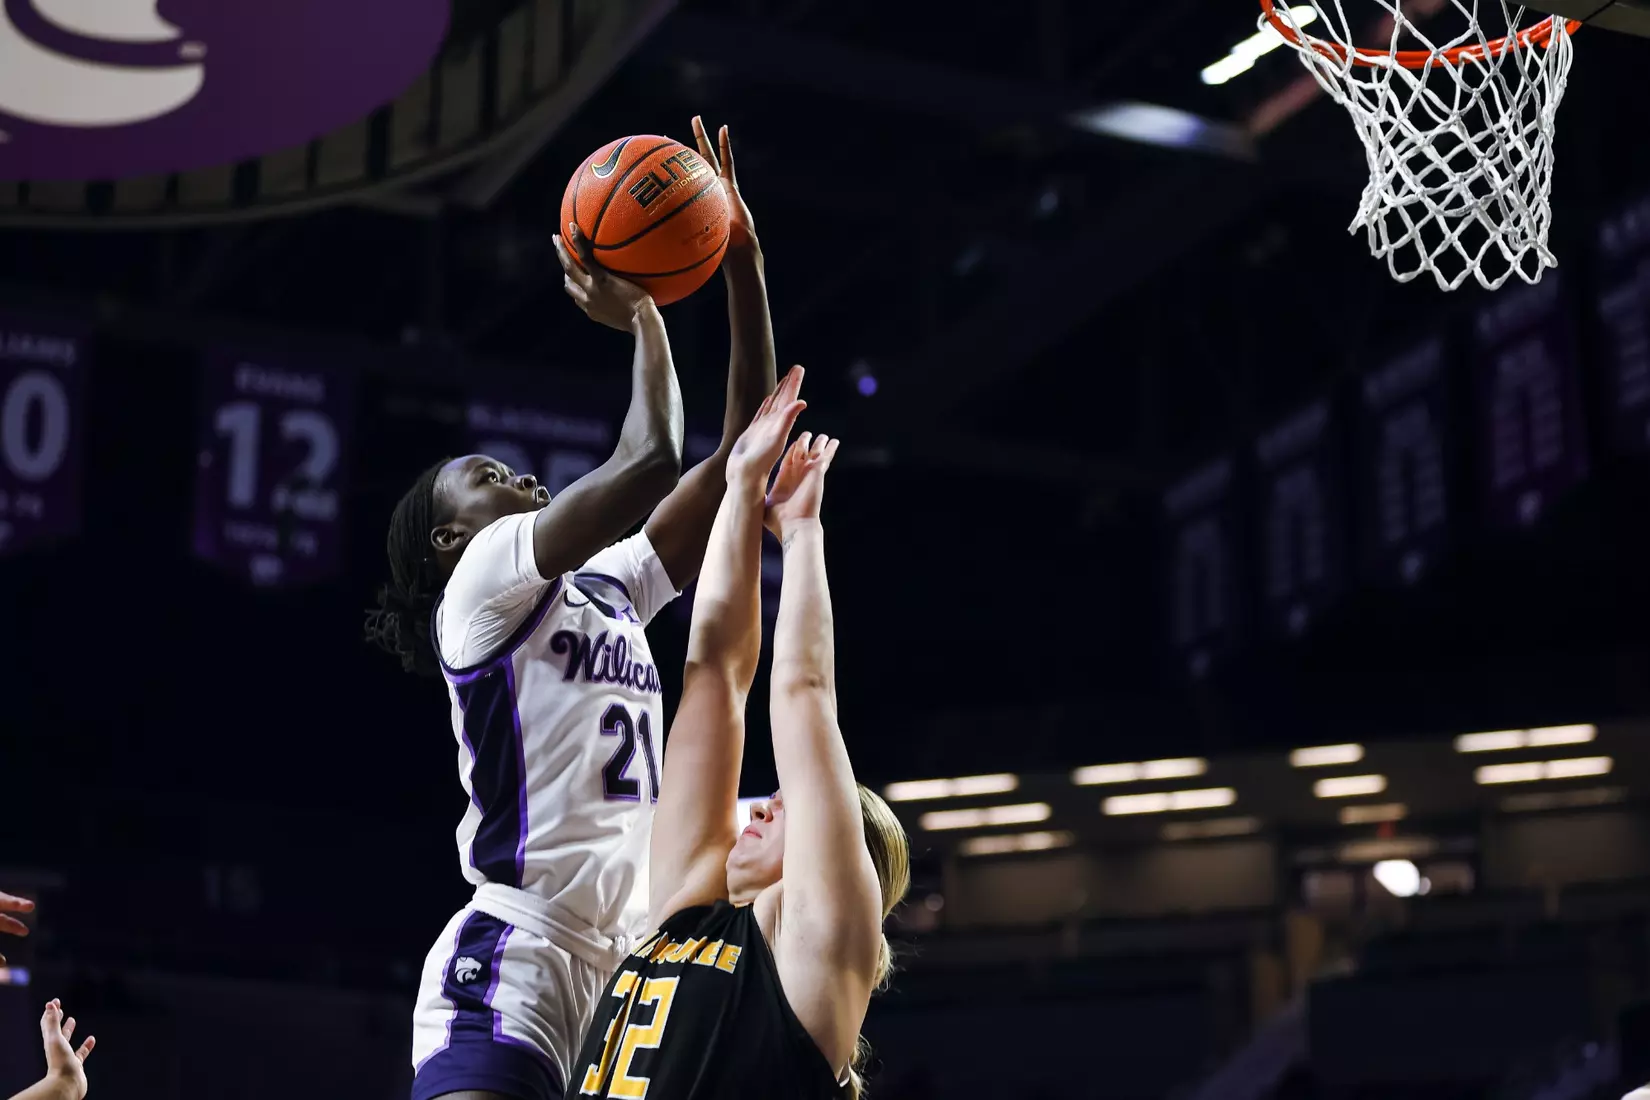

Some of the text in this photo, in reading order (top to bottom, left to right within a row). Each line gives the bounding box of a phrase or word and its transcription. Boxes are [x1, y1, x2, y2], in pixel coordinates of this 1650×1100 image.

[627, 148, 702, 209] ELITE
[213, 400, 342, 522] 12
[600, 702, 660, 805] 21
[579, 969, 681, 1099] 32
